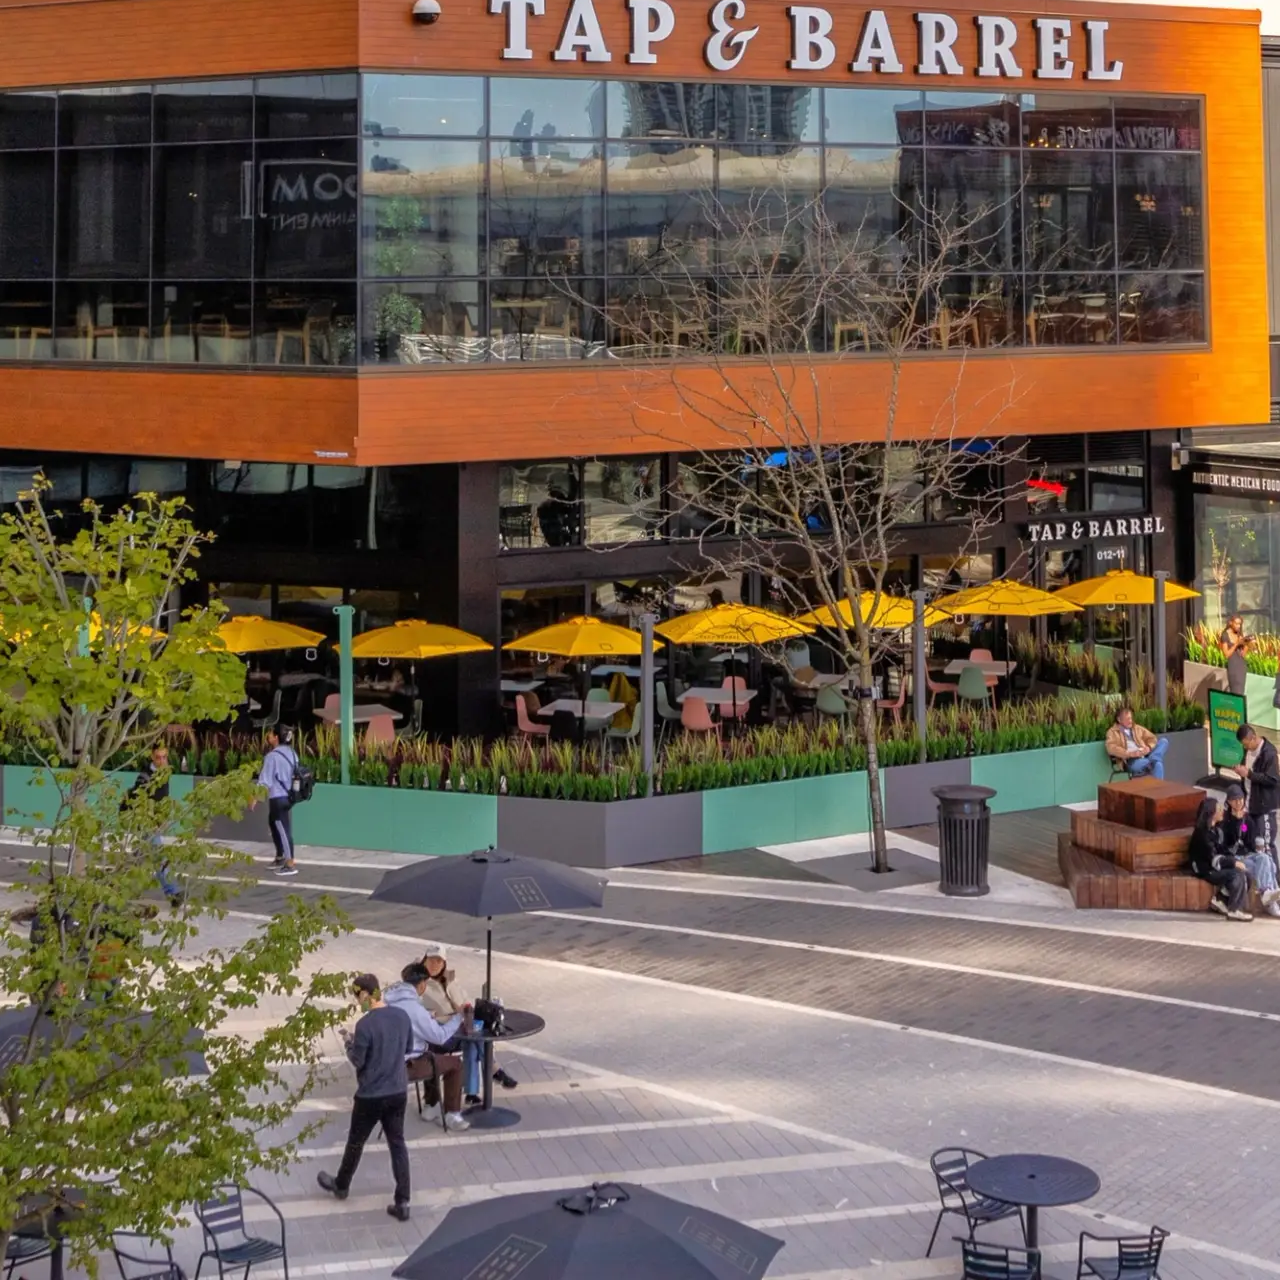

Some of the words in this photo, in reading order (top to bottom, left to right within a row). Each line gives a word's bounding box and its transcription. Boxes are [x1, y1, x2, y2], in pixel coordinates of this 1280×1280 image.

[786, 5, 1125, 82] BARREL
[1192, 471, 1230, 487] AUTHENTIC
[1230, 474, 1261, 490] MEXICAN
[1261, 477, 1280, 492] FOOD
[1028, 522, 1067, 543] TAP
[1071, 521, 1084, 541] &
[1088, 516, 1166, 539] BARREL
[1096, 548, 1126, 561] 012-11
